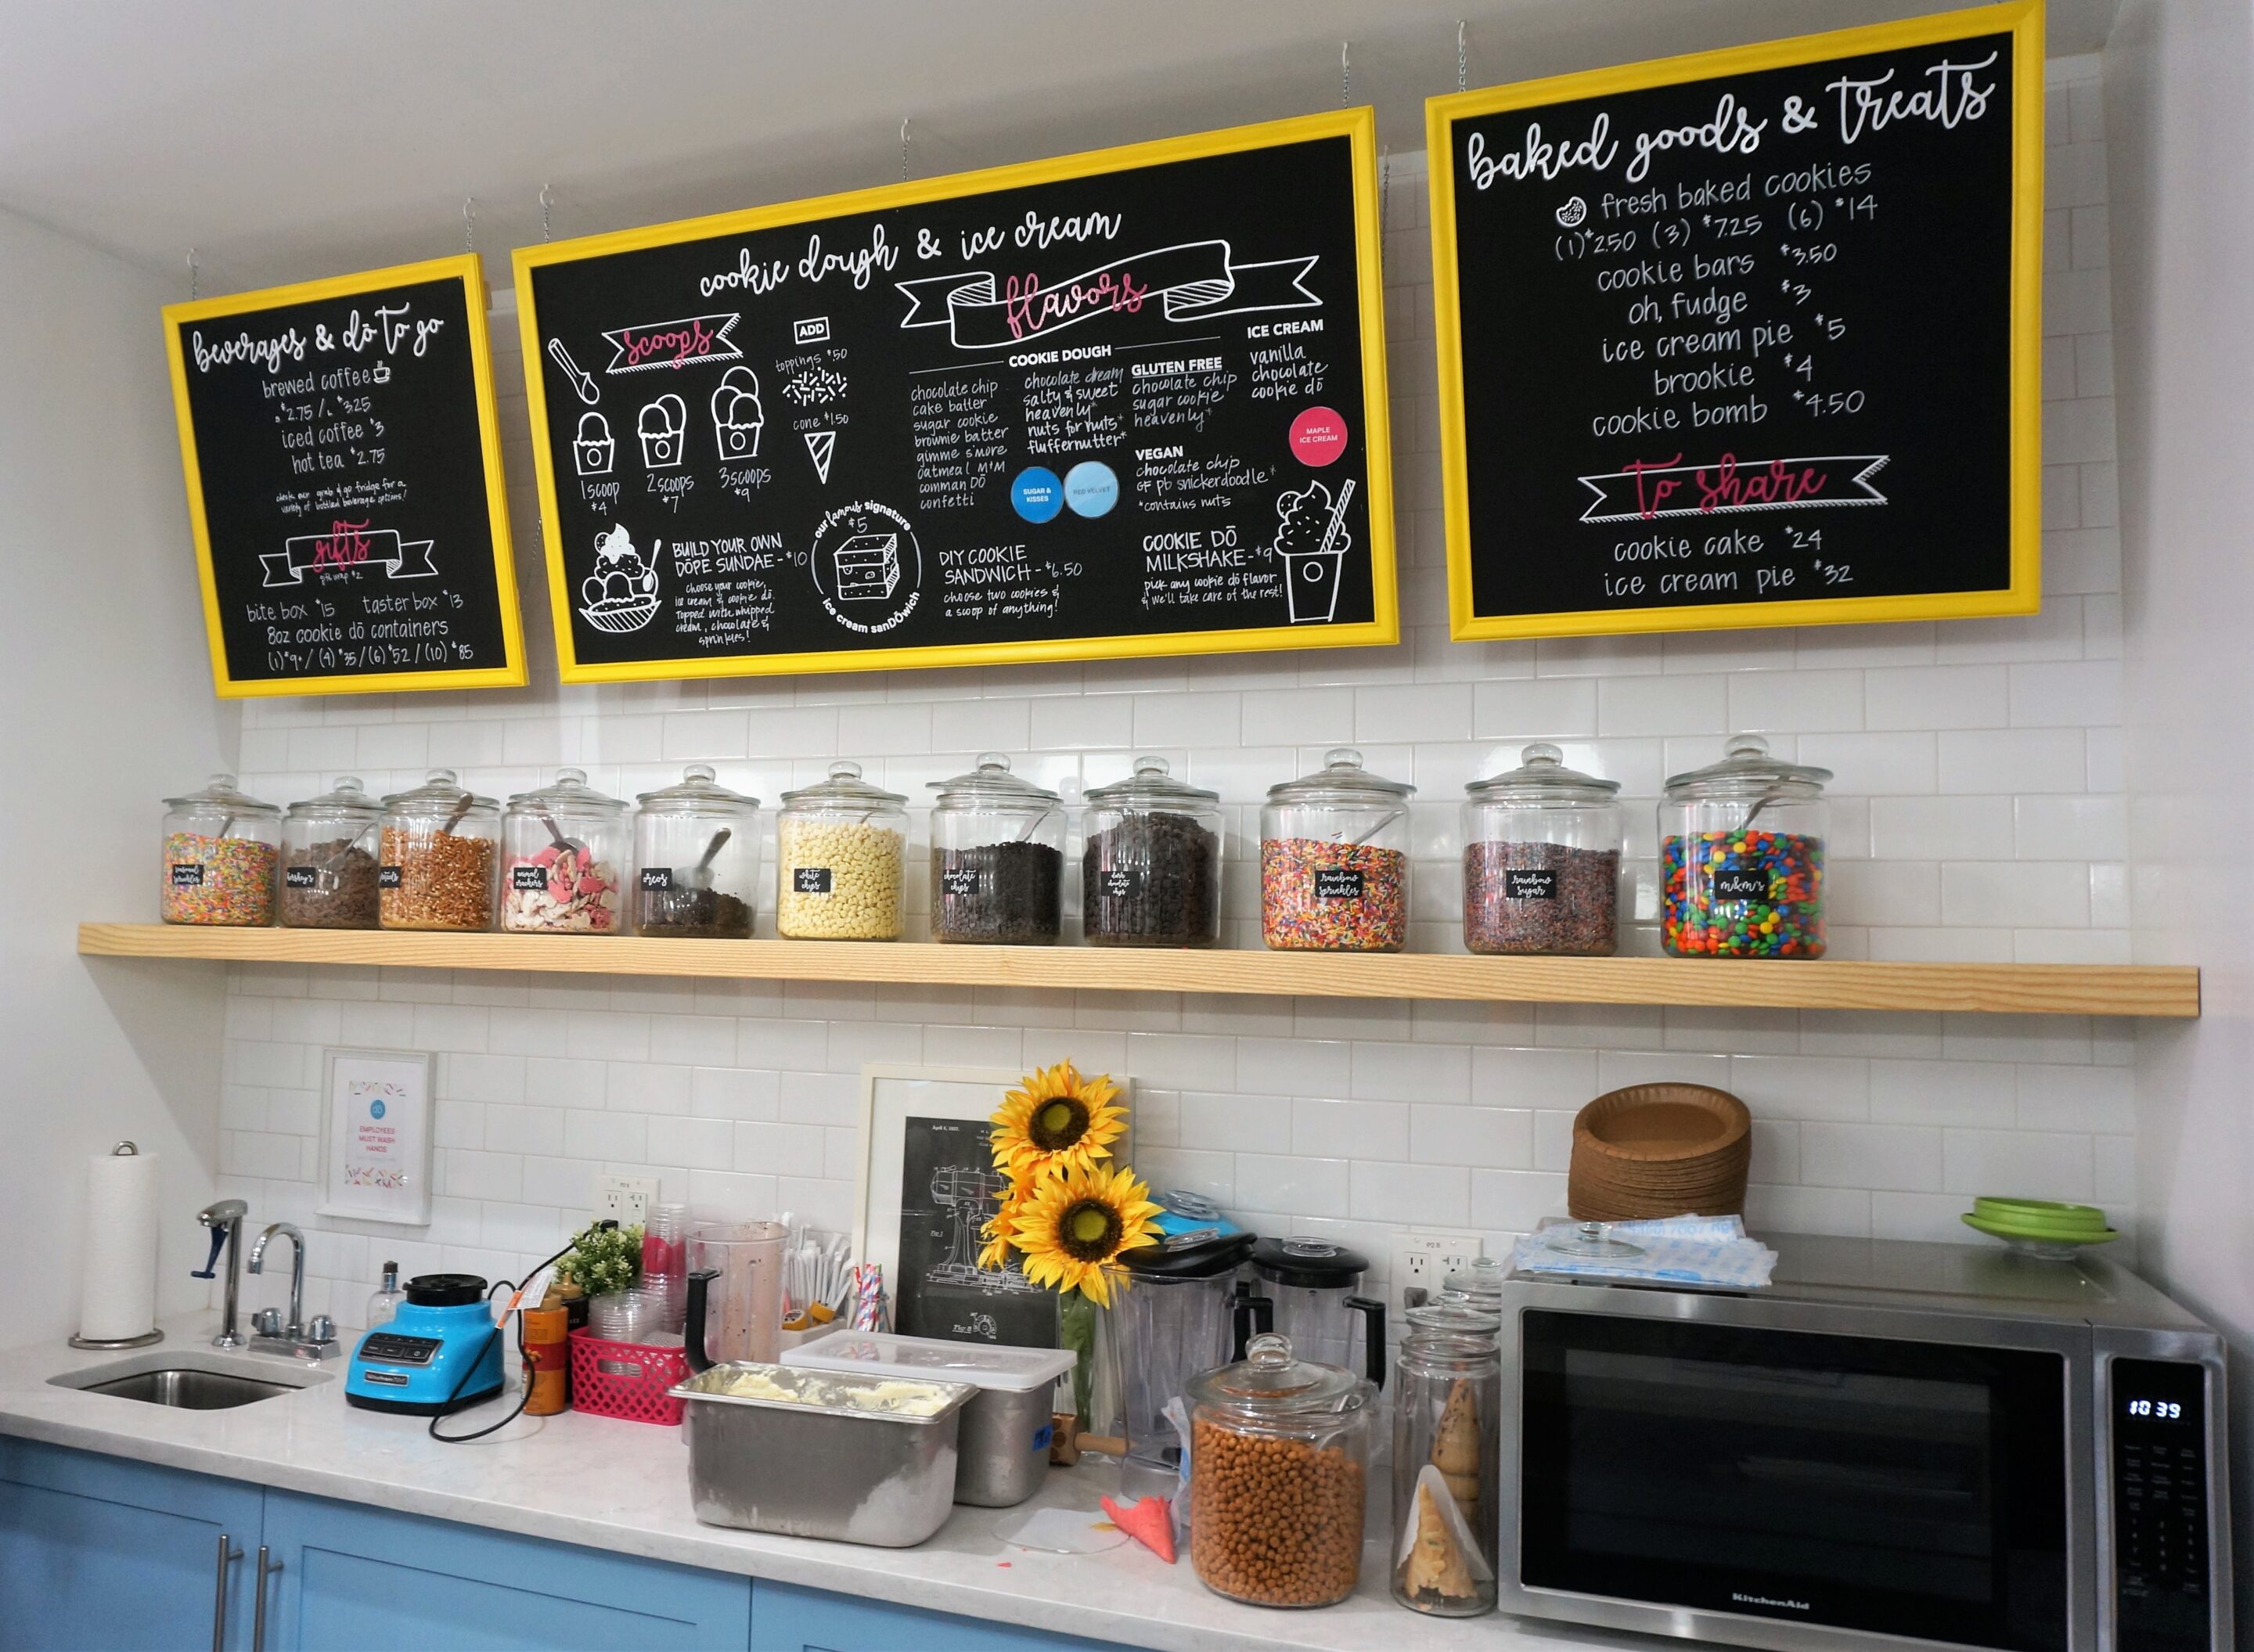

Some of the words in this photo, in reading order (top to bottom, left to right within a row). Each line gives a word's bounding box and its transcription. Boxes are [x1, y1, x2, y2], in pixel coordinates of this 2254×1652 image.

[1468, 113, 1618, 189] baked
[1626, 94, 1768, 184] goods
[1782, 96, 1817, 133] &
[1601, 188, 1666, 218] fresh
[1679, 174, 1750, 208] baked
[1766, 163, 1873, 198] cookies
[700, 248, 789, 297] cookie
[799, 224, 898, 290] dough
[917, 229, 942, 259] &
[961, 227, 1005, 261] ice
[1015, 211, 1122, 249] cream
[1598, 261, 1683, 290] cookie
[1695, 247, 1754, 279] bars
[1006, 272, 1149, 339] flavors
[1672, 287, 1747, 324] fudge
[798, 323, 825, 337] ADD
[1248, 325, 1269, 338] ICE
[1273, 319, 1323, 335] CREAM
[193, 328, 306, 373] beverages
[316, 324, 335, 351] &
[413, 319, 444, 357] go
[624, 319, 714, 369] scoops
[1604, 339, 1644, 362] ice
[1658, 329, 1740, 357] cream
[1753, 320, 1793, 358] pie
[776, 354, 823, 374] toppings
[1009, 351, 1059, 367] COOKIE
[1062, 344, 1111, 361] DOUGH
[1250, 343, 1306, 365] vanilla
[1131, 361, 1184, 376] GLUTEN
[1188, 357, 1222, 372] FREE
[1251, 361, 1328, 382] chocolate
[262, 372, 314, 398] brewed
[322, 367, 370, 390] coffee
[910, 381, 969, 401] chocolate
[972, 379, 998, 398] chip
[1024, 371, 1080, 389] chocolate
[1655, 362, 1754, 396] brookie
[1023, 392, 1062, 411] salty
[1076, 382, 1118, 400] sweet
[1252, 382, 1298, 401] cookie
[913, 401, 942, 416] cake
[949, 398, 987, 412] batter
[1593, 407, 1680, 436] cookie
[1693, 394, 1767, 426] bomb
[794, 418, 820, 430] cone
[913, 419, 950, 433] sugar
[958, 413, 998, 428] cookie
[1028, 421, 1060, 437] nuts
[1065, 419, 1083, 435] for
[1306, 426, 1330, 434] MAPLE
[282, 426, 313, 448] iced
[319, 422, 363, 443] coffee
[915, 430, 960, 447] brownie
[965, 427, 1008, 442] batter
[292, 452, 314, 473] hot
[319, 452, 344, 469] tea
[1136, 446, 1183, 461] VEGAN
[1136, 459, 1199, 477] chocolate
[1207, 454, 1240, 473] chip
[1137, 480, 1151, 492] GF
[1157, 477, 1172, 496] pb
[1694, 452, 1827, 513] share
[920, 494, 974, 509] confetti
[815, 523, 828, 538] our
[864, 500, 910, 531] signature
[672, 540, 709, 558] BUILD
[711, 537, 747, 555] YOUR
[751, 532, 782, 552] OWN
[1143, 532, 1201, 552] COOKIE
[1615, 535, 1691, 561] cookie
[1705, 529, 1763, 555] cake
[716, 554, 774, 573] SUNDAE
[939, 550, 964, 566] DIY
[968, 545, 1028, 565] COOKIE
[1143, 548, 1246, 572] MILKSHAKE
[945, 563, 1032, 585] SANDWICH
[1605, 573, 1645, 596] ice
[1661, 572, 1737, 593] cream
[1758, 567, 1795, 593] pie
[362, 595, 409, 614] taster
[412, 592, 437, 610] box
[944, 592, 982, 603] choose
[987, 589, 1006, 601] two
[1011, 588, 1048, 599] cookies
[247, 604, 275, 621] bite
[280, 603, 307, 619] box
[268, 627, 290, 645] 8oz
[297, 624, 342, 642] cookie
[372, 618, 448, 638] containers
[359, 1125, 395, 1134] EMPLOYEES
[1732, 1593, 1810, 1611] KitchenAid
